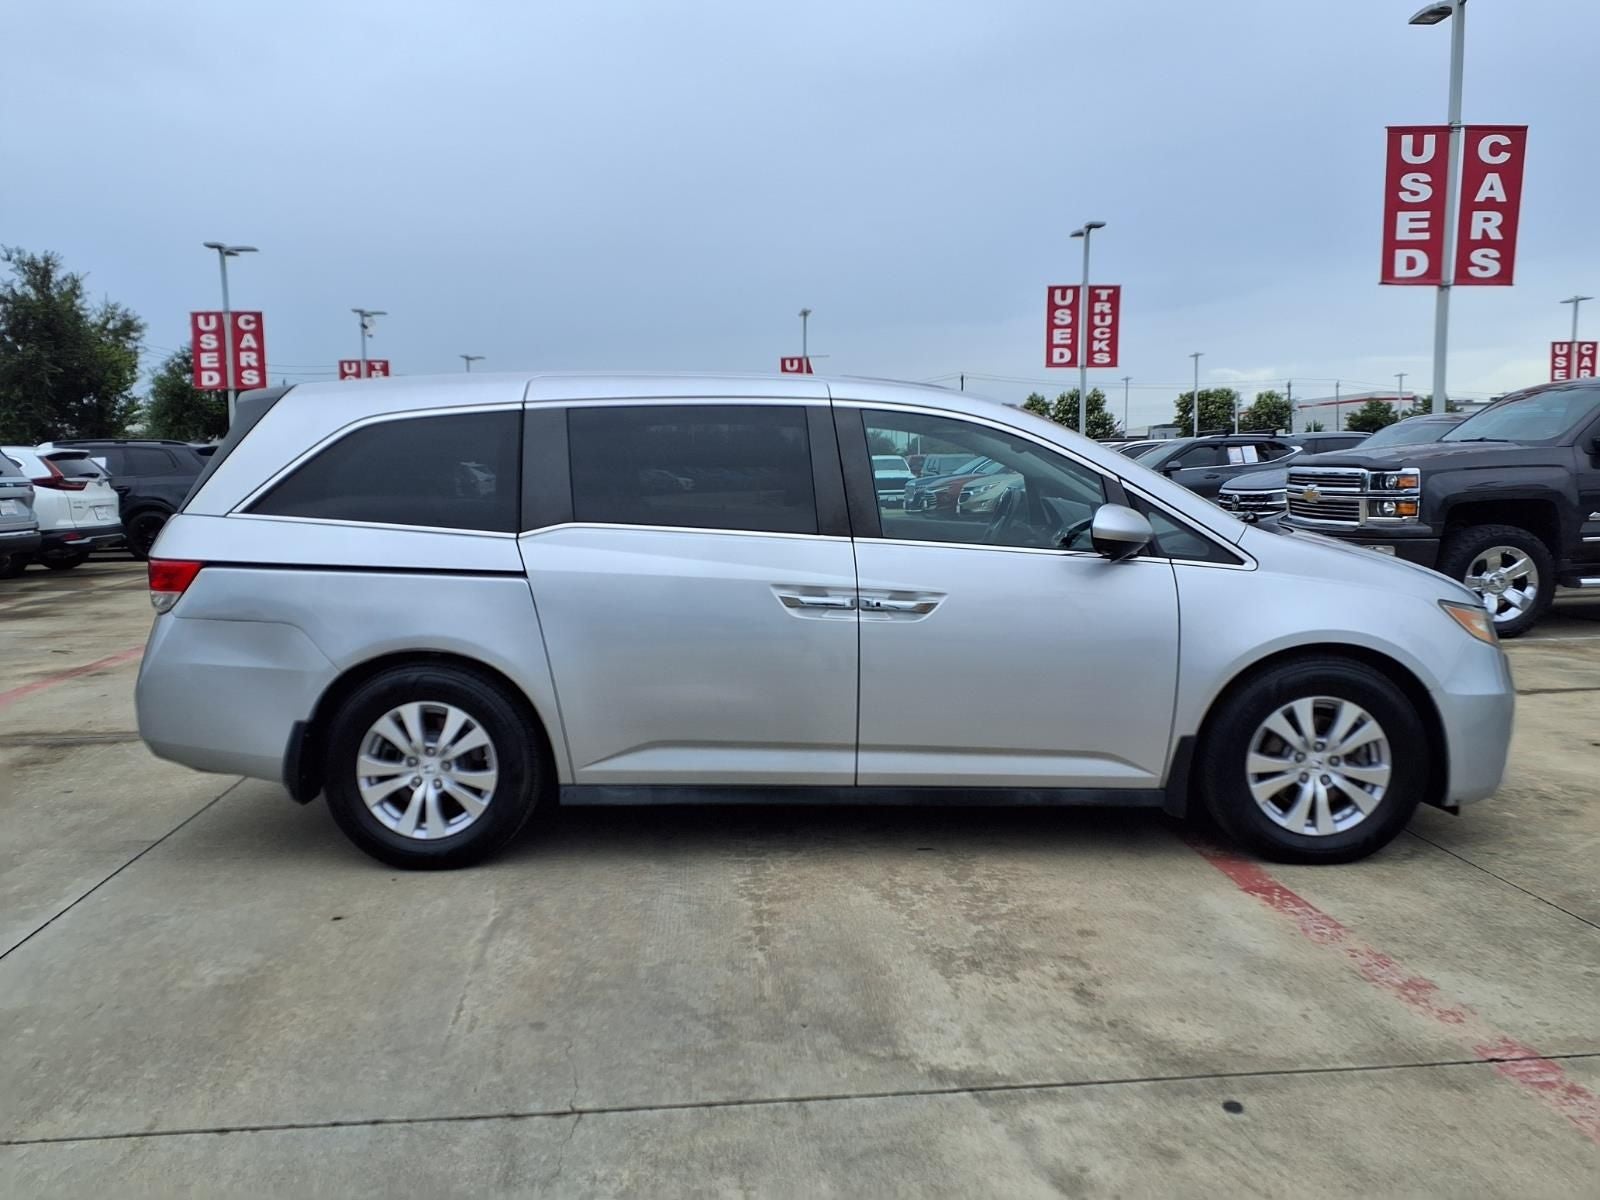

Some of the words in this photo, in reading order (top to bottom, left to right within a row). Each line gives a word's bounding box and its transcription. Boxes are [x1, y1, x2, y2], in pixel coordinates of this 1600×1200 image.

[1394, 134, 1436, 278] USED
[1467, 134, 1512, 278] CARS
[197, 315, 221, 386] USED
[237, 314, 260, 386] CARS
[1052, 289, 1074, 364] USED
[1092, 289, 1114, 364] TRUCKS
